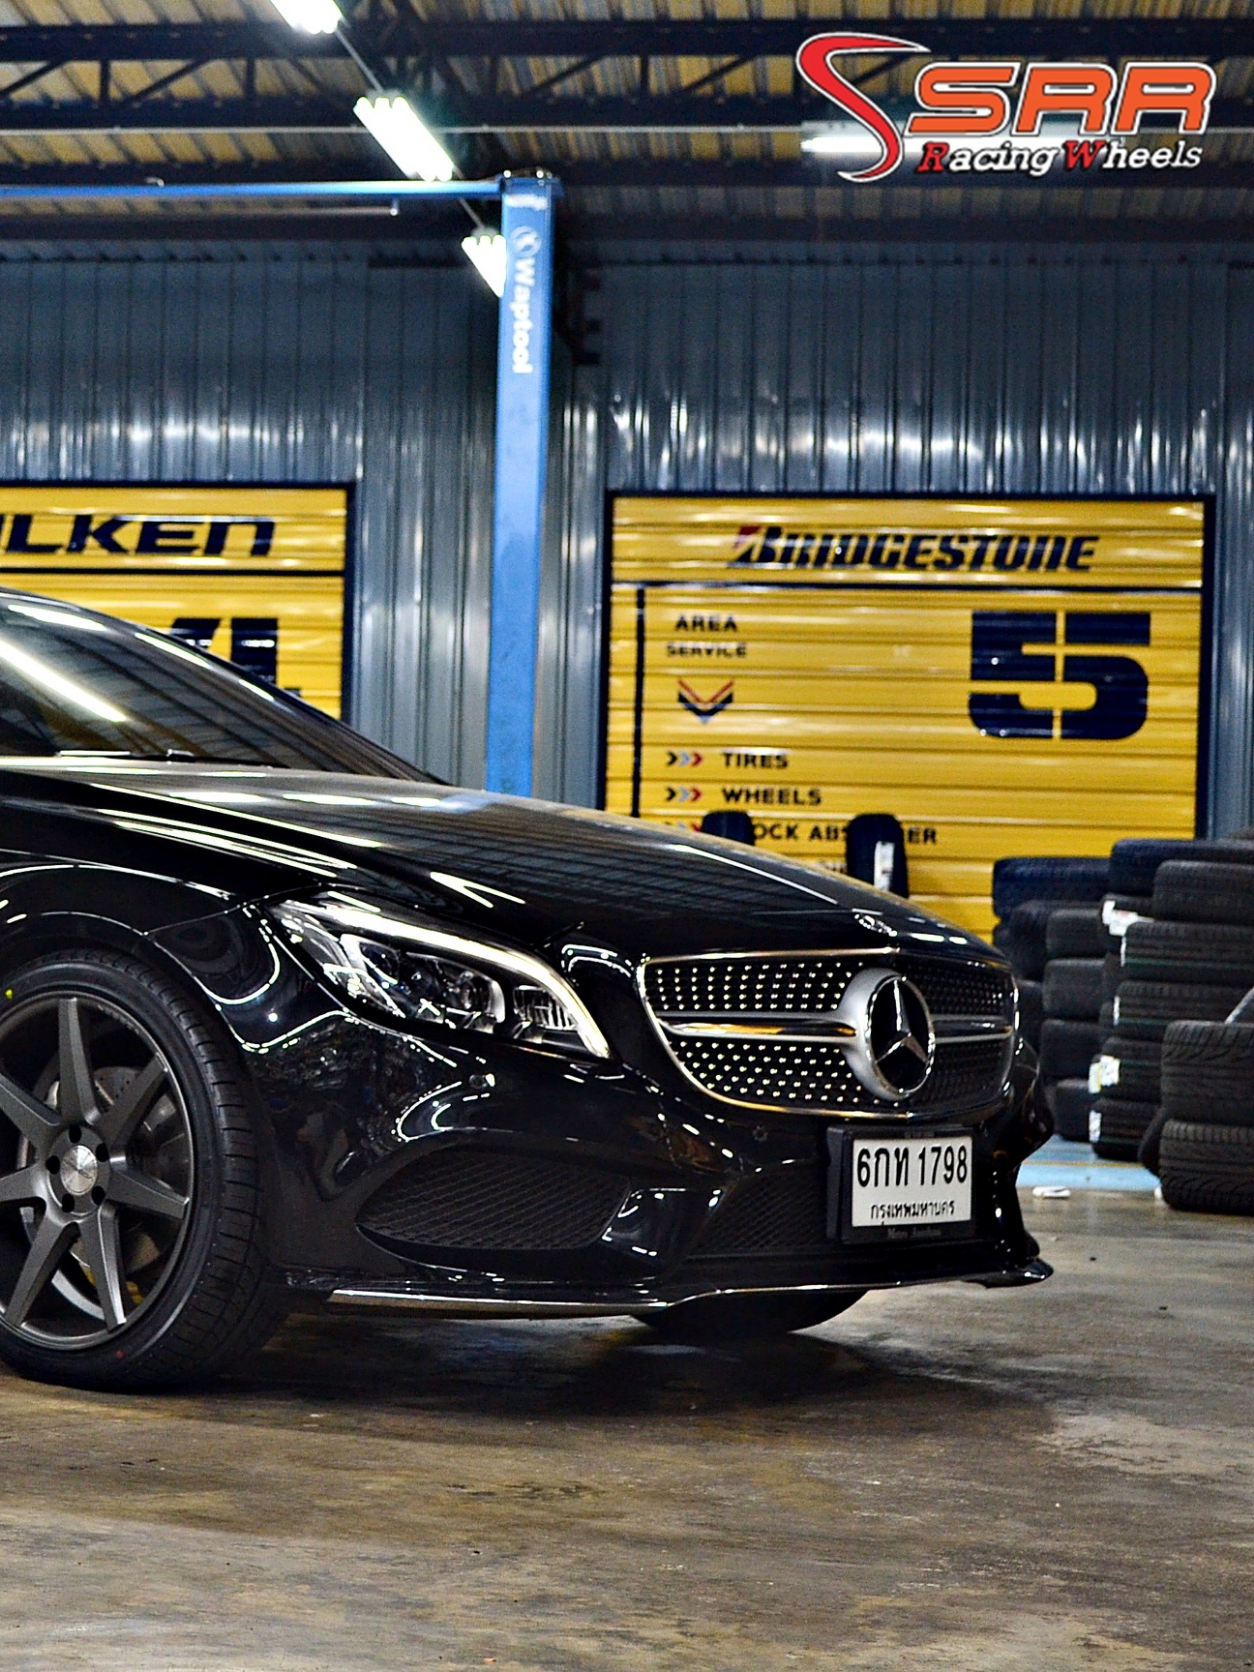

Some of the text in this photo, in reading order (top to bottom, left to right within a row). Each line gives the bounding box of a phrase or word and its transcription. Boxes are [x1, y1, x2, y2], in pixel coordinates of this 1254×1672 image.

[509, 257, 536, 374] Waptool
[726, 526, 1100, 571] BRIDGESTONE
[675, 615, 738, 633] AREA
[665, 641, 748, 659] SERVICE
[968, 610, 1151, 739] 5
[721, 751, 789, 770] TIRES
[721, 787, 823, 806] WHEELS
[753, 822, 799, 841] OCK
[856, 1144, 968, 1188] 6กท 1798
[870, 1200, 955, 1225] กรุงเทพมหานคร
